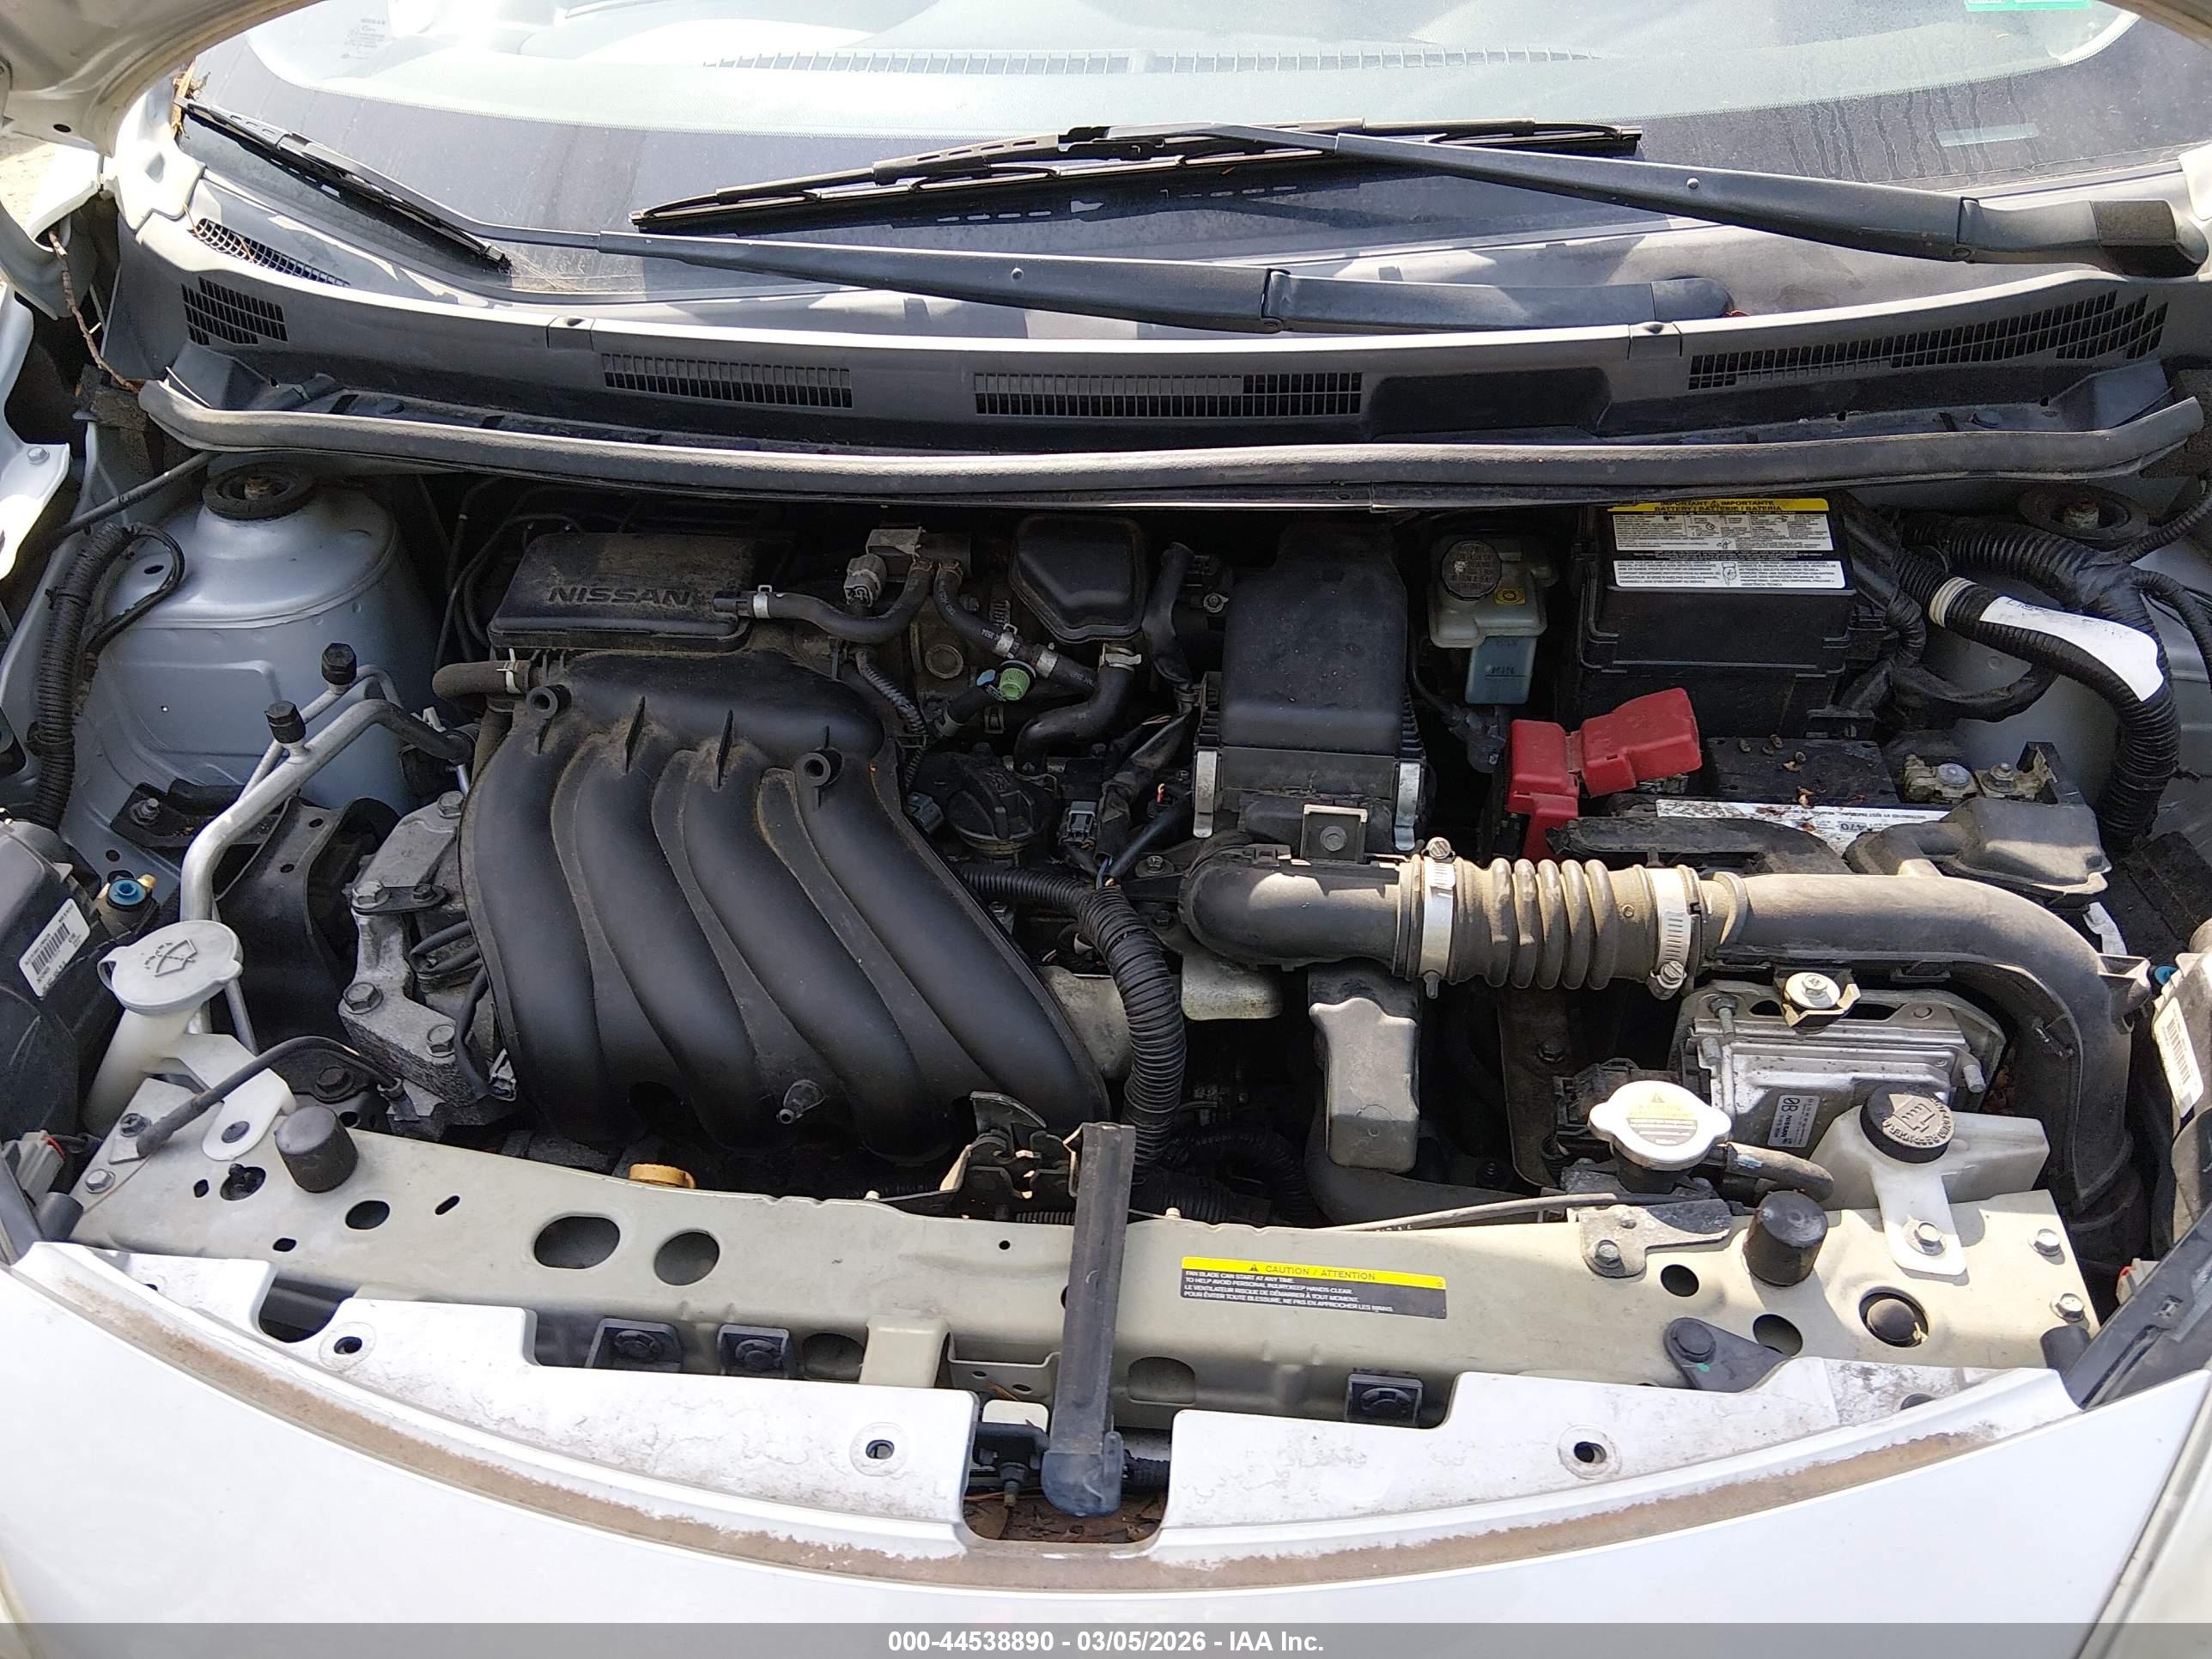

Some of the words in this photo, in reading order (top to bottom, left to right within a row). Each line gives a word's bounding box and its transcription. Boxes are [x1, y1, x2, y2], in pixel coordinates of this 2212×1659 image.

[547, 586, 692, 609] NISSAN
[1780, 1115, 1793, 1138] NISSAN
[1266, 1265, 1308, 1275] CAUTION
[1321, 1269, 1374, 1279] ATTENTION
[1316, 1301, 1357, 1310] APPROCHER
